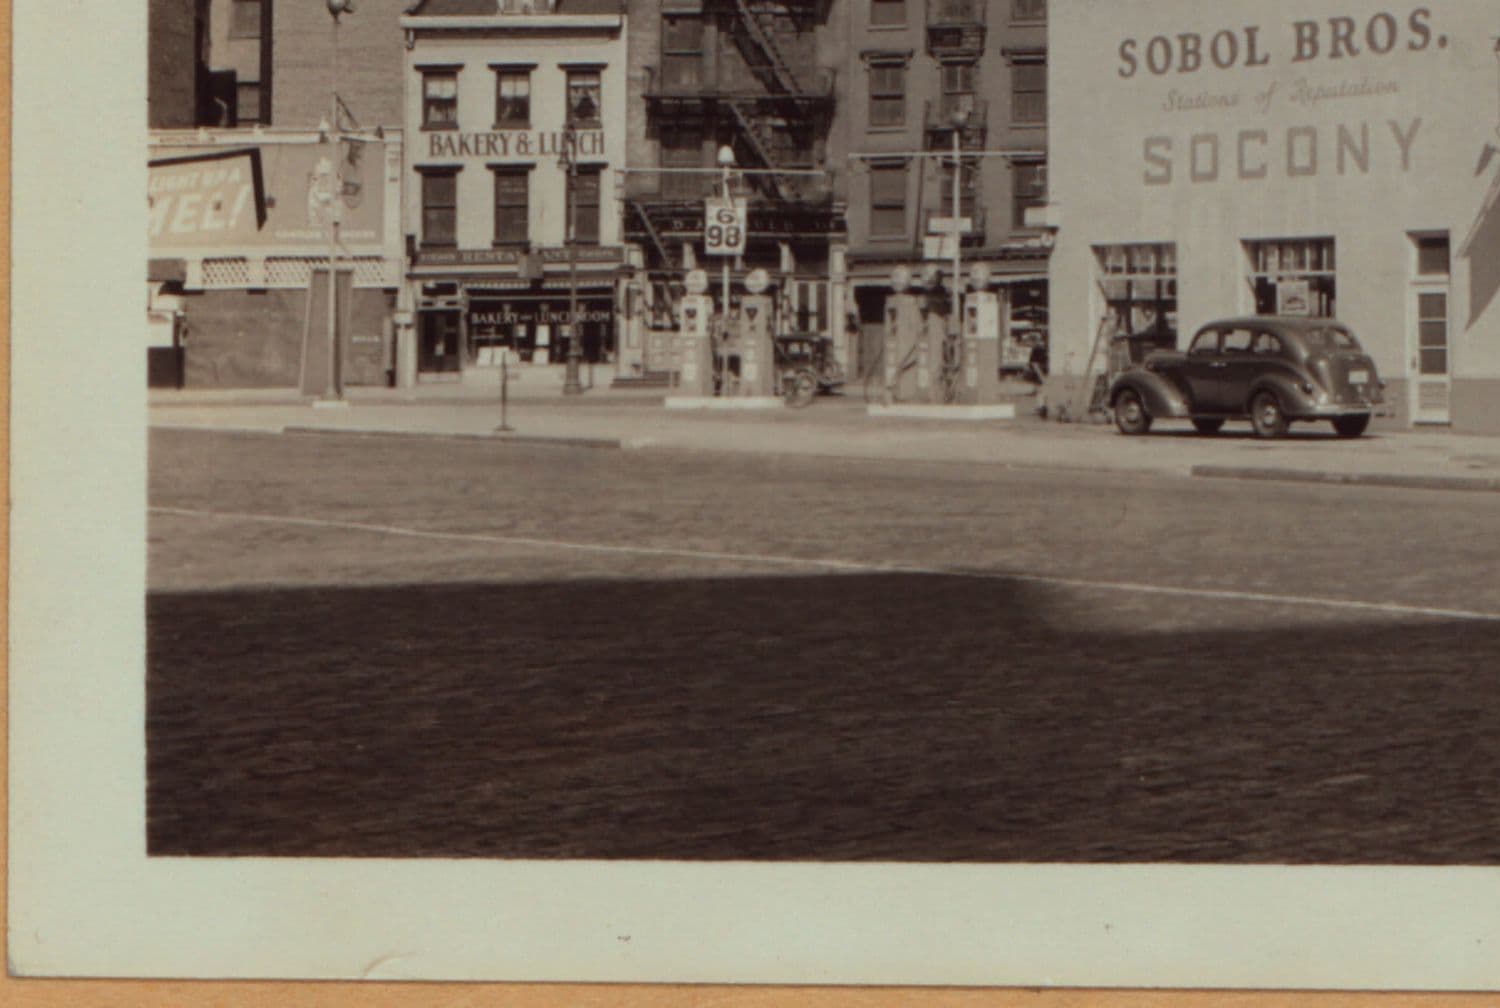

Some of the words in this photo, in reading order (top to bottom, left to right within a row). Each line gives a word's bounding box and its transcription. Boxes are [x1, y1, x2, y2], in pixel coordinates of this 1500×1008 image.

[1118, 26, 1271, 79] SOBOL
[1290, 7, 1448, 63] BROS.
[1162, 88, 1240, 112] Stations
[1253, 80, 1278, 115] of
[1288, 76, 1399, 105] Reputation
[429, 132, 511, 157] BAKERY
[516, 132, 534, 156] &
[538, 131, 605, 156] LUNCH
[1144, 117, 1422, 185] SOCONY
[715, 207, 737, 225] 6
[707, 226, 741, 248] 98
